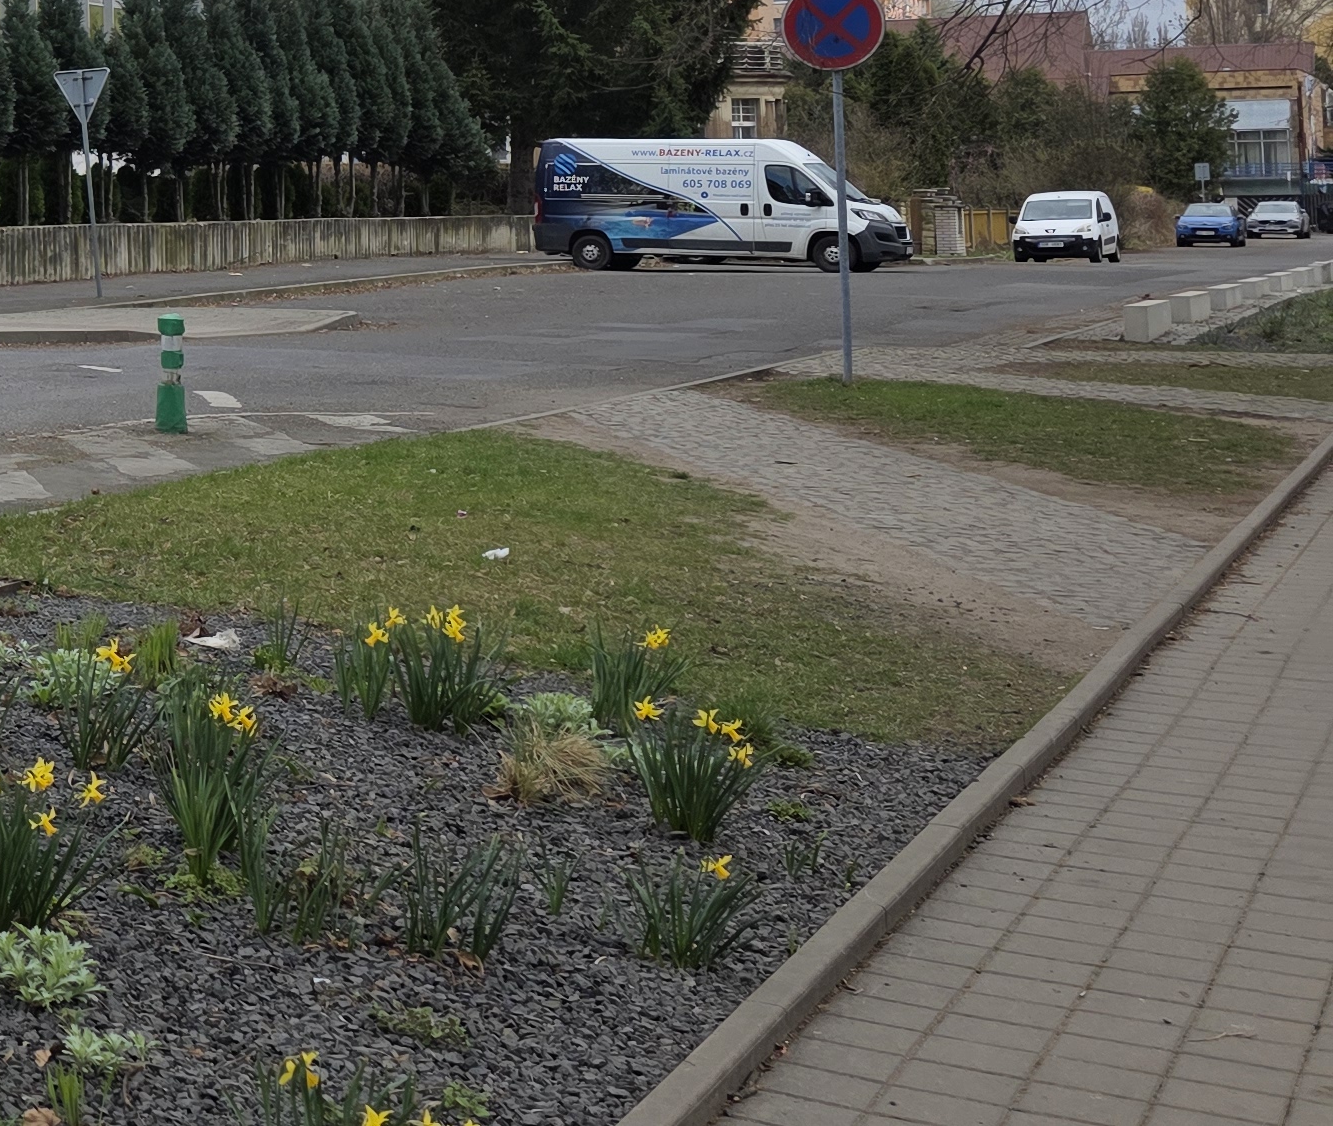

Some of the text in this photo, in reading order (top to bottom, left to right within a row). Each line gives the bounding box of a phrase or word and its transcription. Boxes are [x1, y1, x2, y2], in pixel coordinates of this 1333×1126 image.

[631, 148, 754, 157] www.BAZENY-RELAX.cz
[660, 167, 749, 176] laminátové bazény
[553, 175, 589, 183] BAZÉNY
[682, 179, 752, 189] 605 708 069
